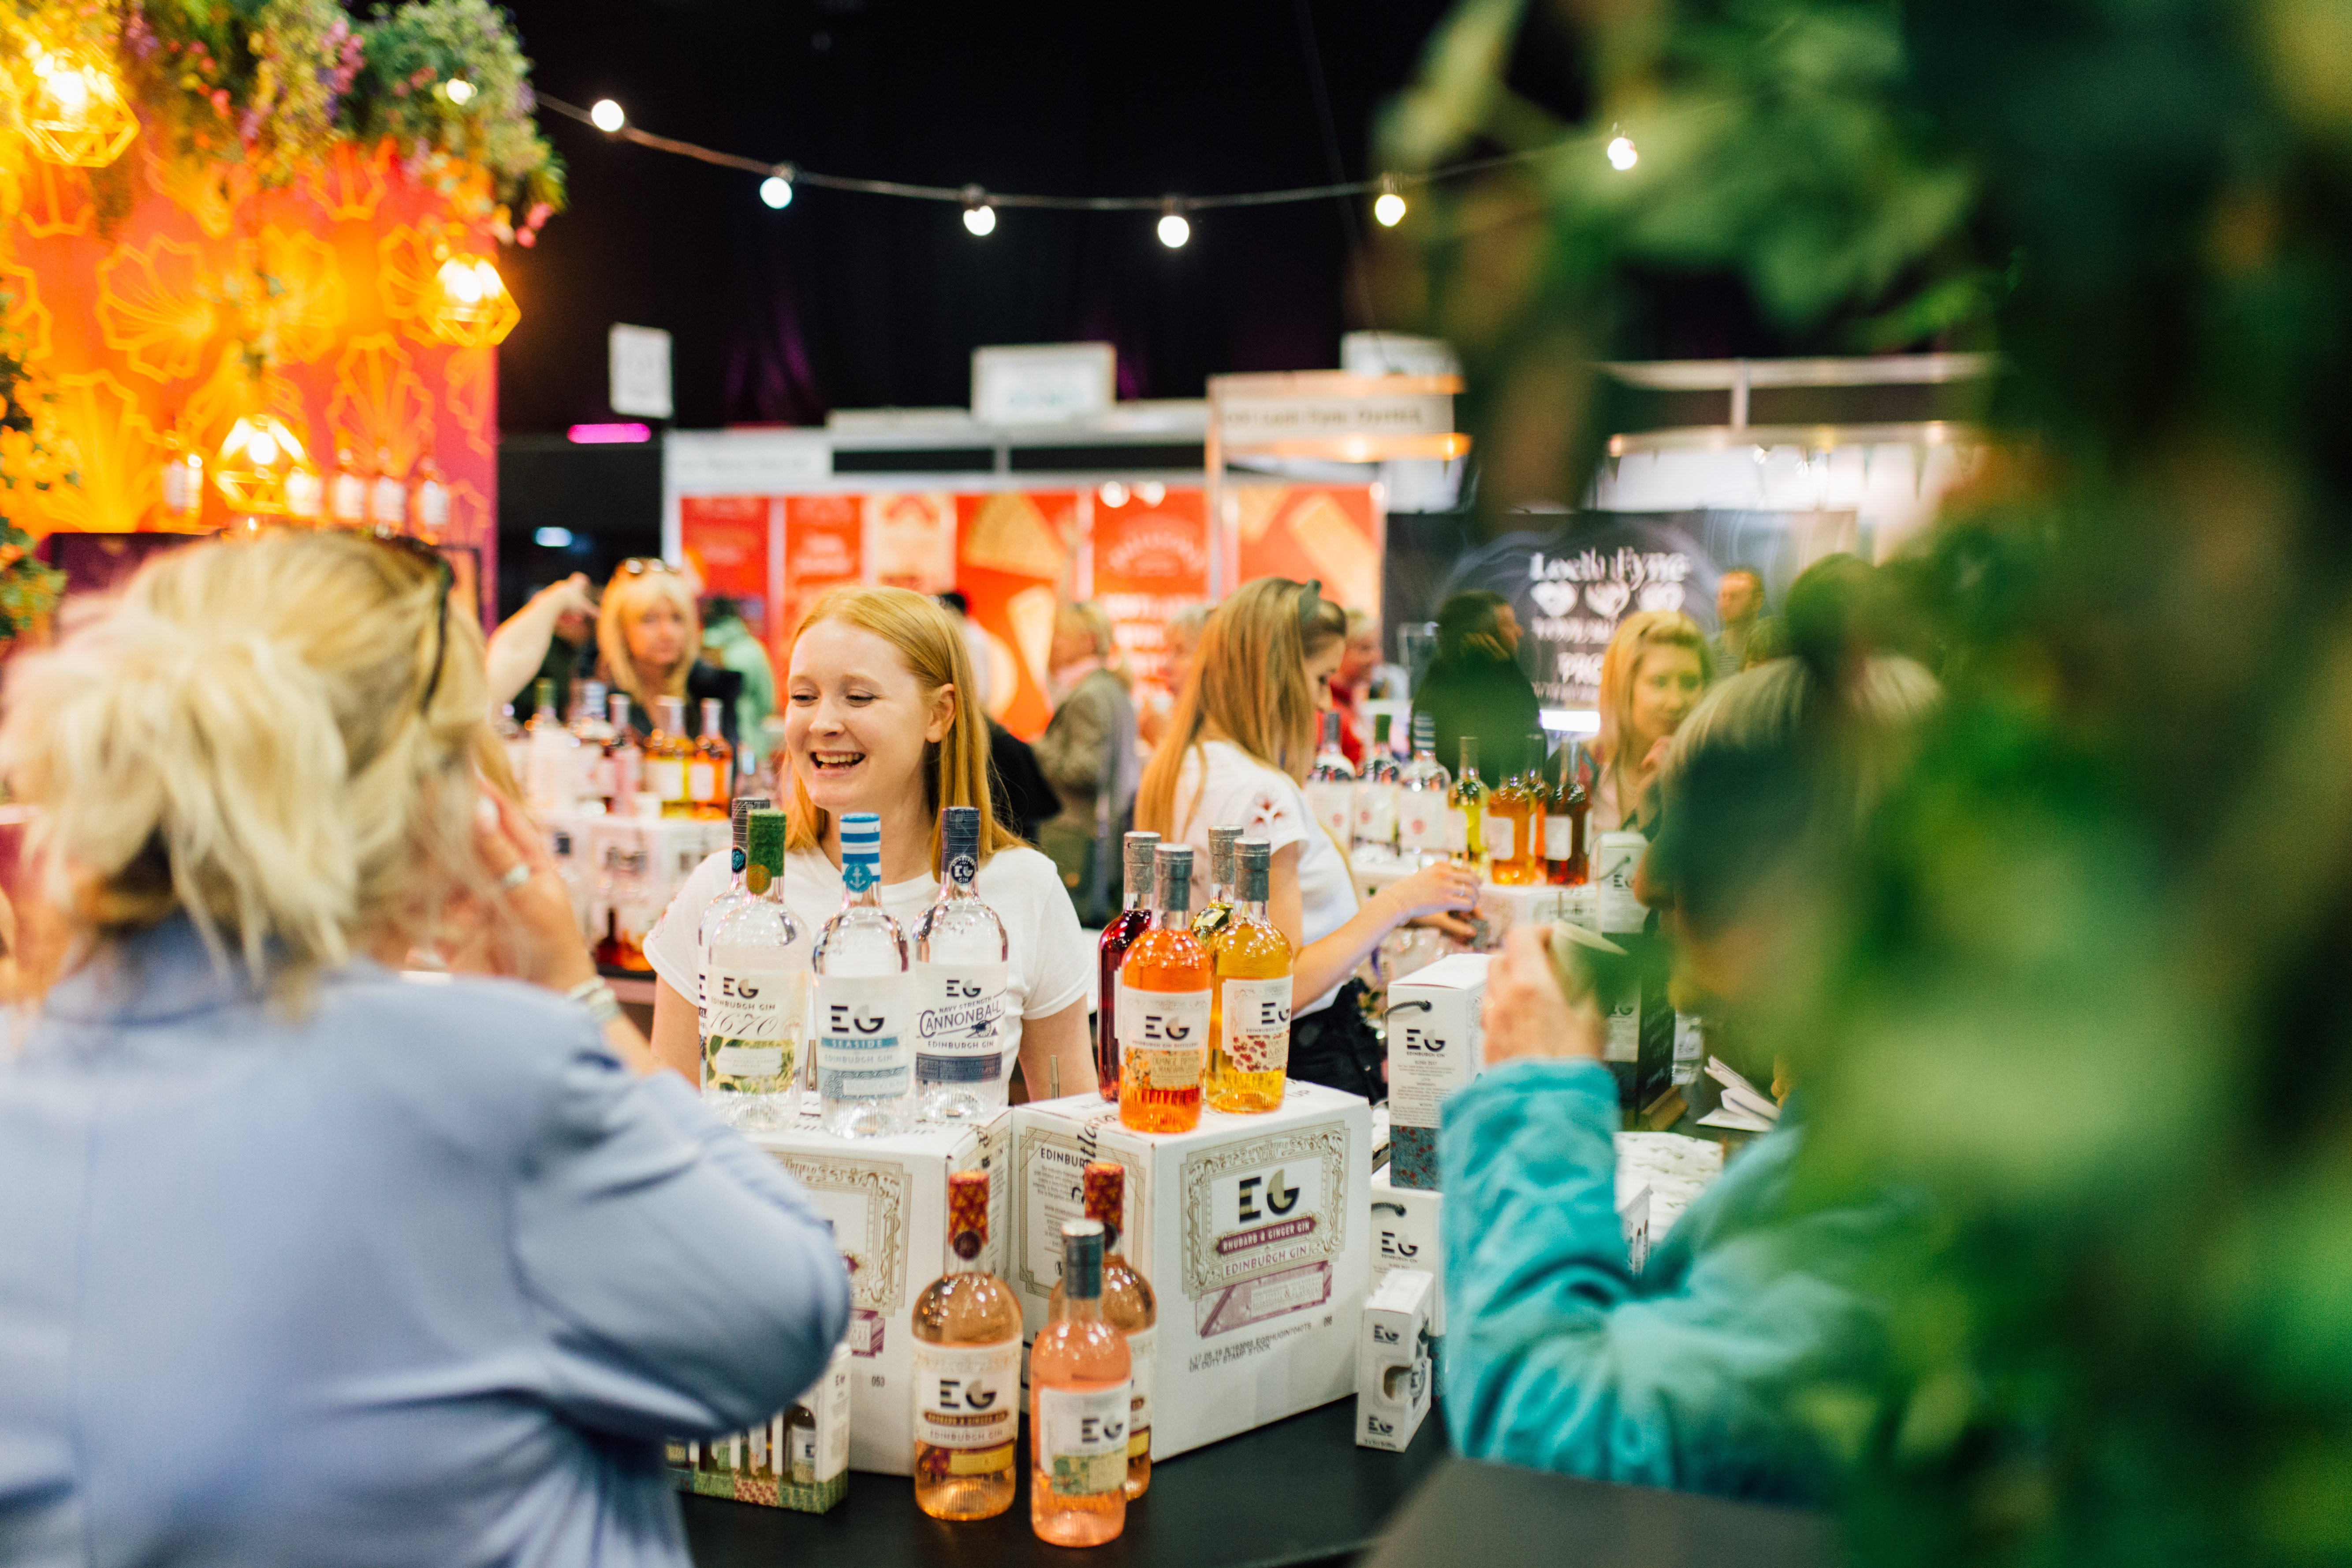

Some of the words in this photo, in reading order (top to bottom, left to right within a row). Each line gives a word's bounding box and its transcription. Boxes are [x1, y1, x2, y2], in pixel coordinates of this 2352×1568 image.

[954, 865, 973, 878] EG
[723, 976, 759, 1000] EG
[946, 979, 982, 998] EG
[711, 996, 755, 1010] EDINBURGH
[939, 1005, 957, 1014] NAVY
[959, 996, 992, 1009] STRENGTH
[710, 1010, 779, 1037] 1670
[831, 1005, 885, 1035] EG
[920, 1000, 1001, 1039] CANNONBALL
[1145, 1015, 1190, 1041] EG
[831, 1039, 883, 1049] SEASIDE
[928, 1040, 979, 1049] EDINBURGH
[982, 1040, 994, 1049] GIN
[1406, 1028, 1446, 1052] EG
[824, 1054, 874, 1064] EDINBURGH
[878, 1054, 893, 1063] GIN
[1040, 1147, 1085, 1169] EDINBUR
[1248, 1142, 1288, 1157] SPENCERFIELD
[1257, 1148, 1279, 1160] SPIRIT
[1239, 1169, 1300, 1224] EG
[1223, 1234, 1258, 1252] RHUBARB
[1260, 1233, 1265, 1242] &
[1268, 1225, 1295, 1240] GINGER
[1297, 1221, 1310, 1233] GIN
[1381, 1231, 1419, 1257] EG
[1226, 1250, 1286, 1276] EDINBURGH
[1290, 1245, 1307, 1258] GIN
[1374, 1324, 1399, 1341] EG
[1201, 1358, 1219, 1370] DUTY
[1223, 1350, 1246, 1363] STAMP
[1249, 1344, 1271, 1356] STOCK
[940, 1379, 997, 1411] EG
[930, 1430, 985, 1441] EDINBURGH
[988, 1430, 1003, 1439] GIN
[1081, 1417, 1123, 1444] EG
[1368, 1415, 1394, 1433] EG
